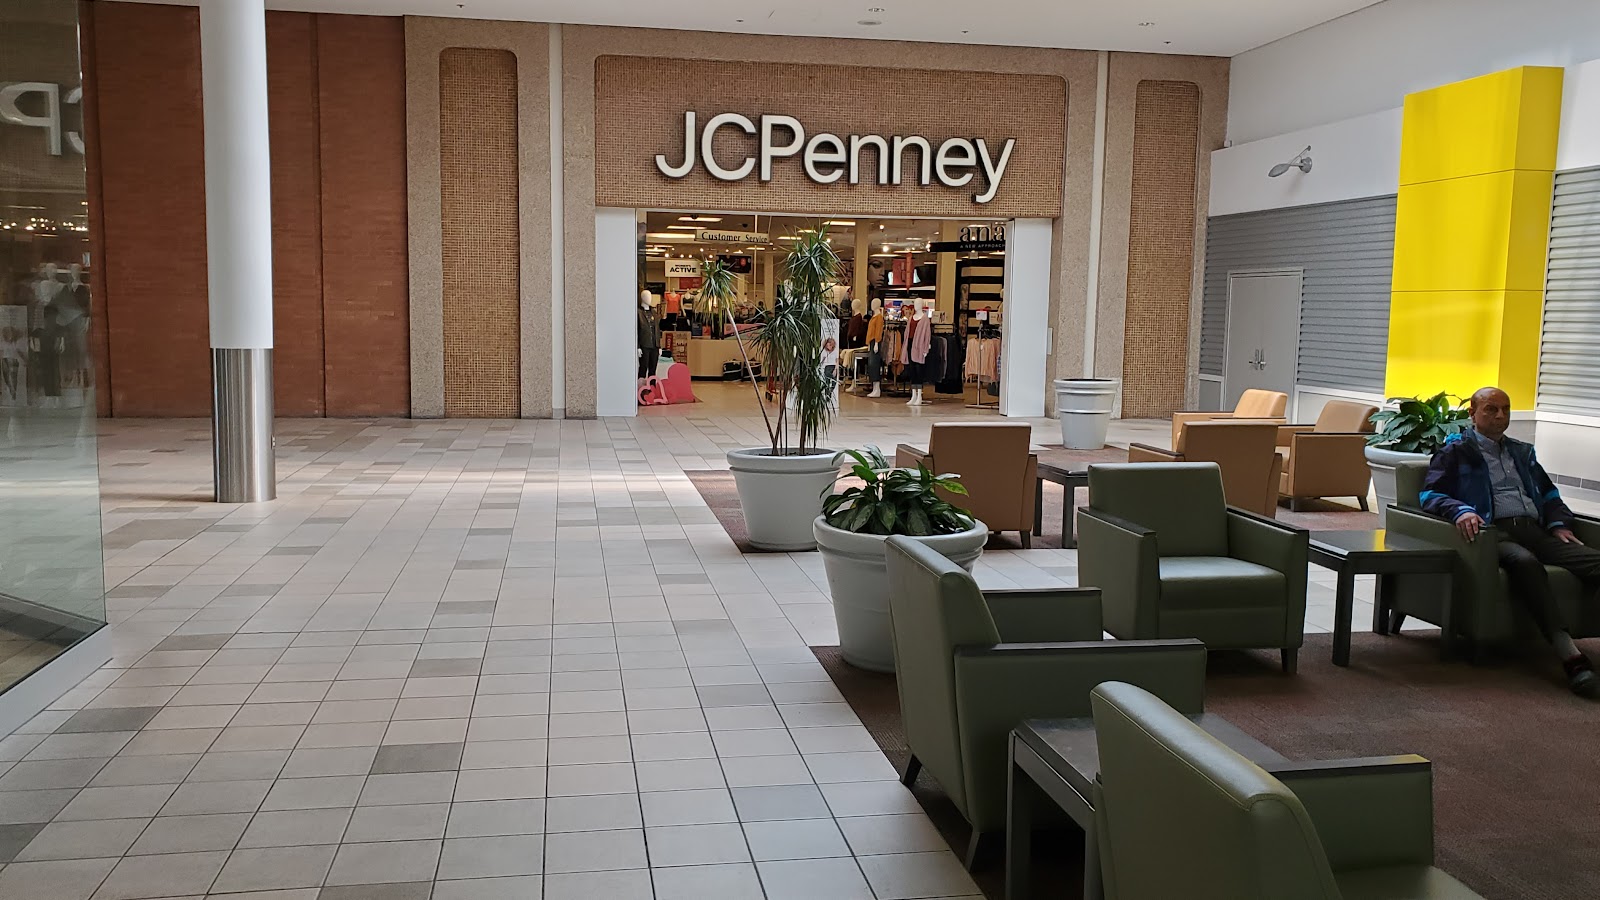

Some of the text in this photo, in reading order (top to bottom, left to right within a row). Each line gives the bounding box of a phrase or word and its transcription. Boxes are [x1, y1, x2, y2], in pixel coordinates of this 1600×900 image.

[655, 110, 1017, 204] JCPenney
[701, 231, 768, 243] Customer Service
[960, 226, 1006, 242] ana
